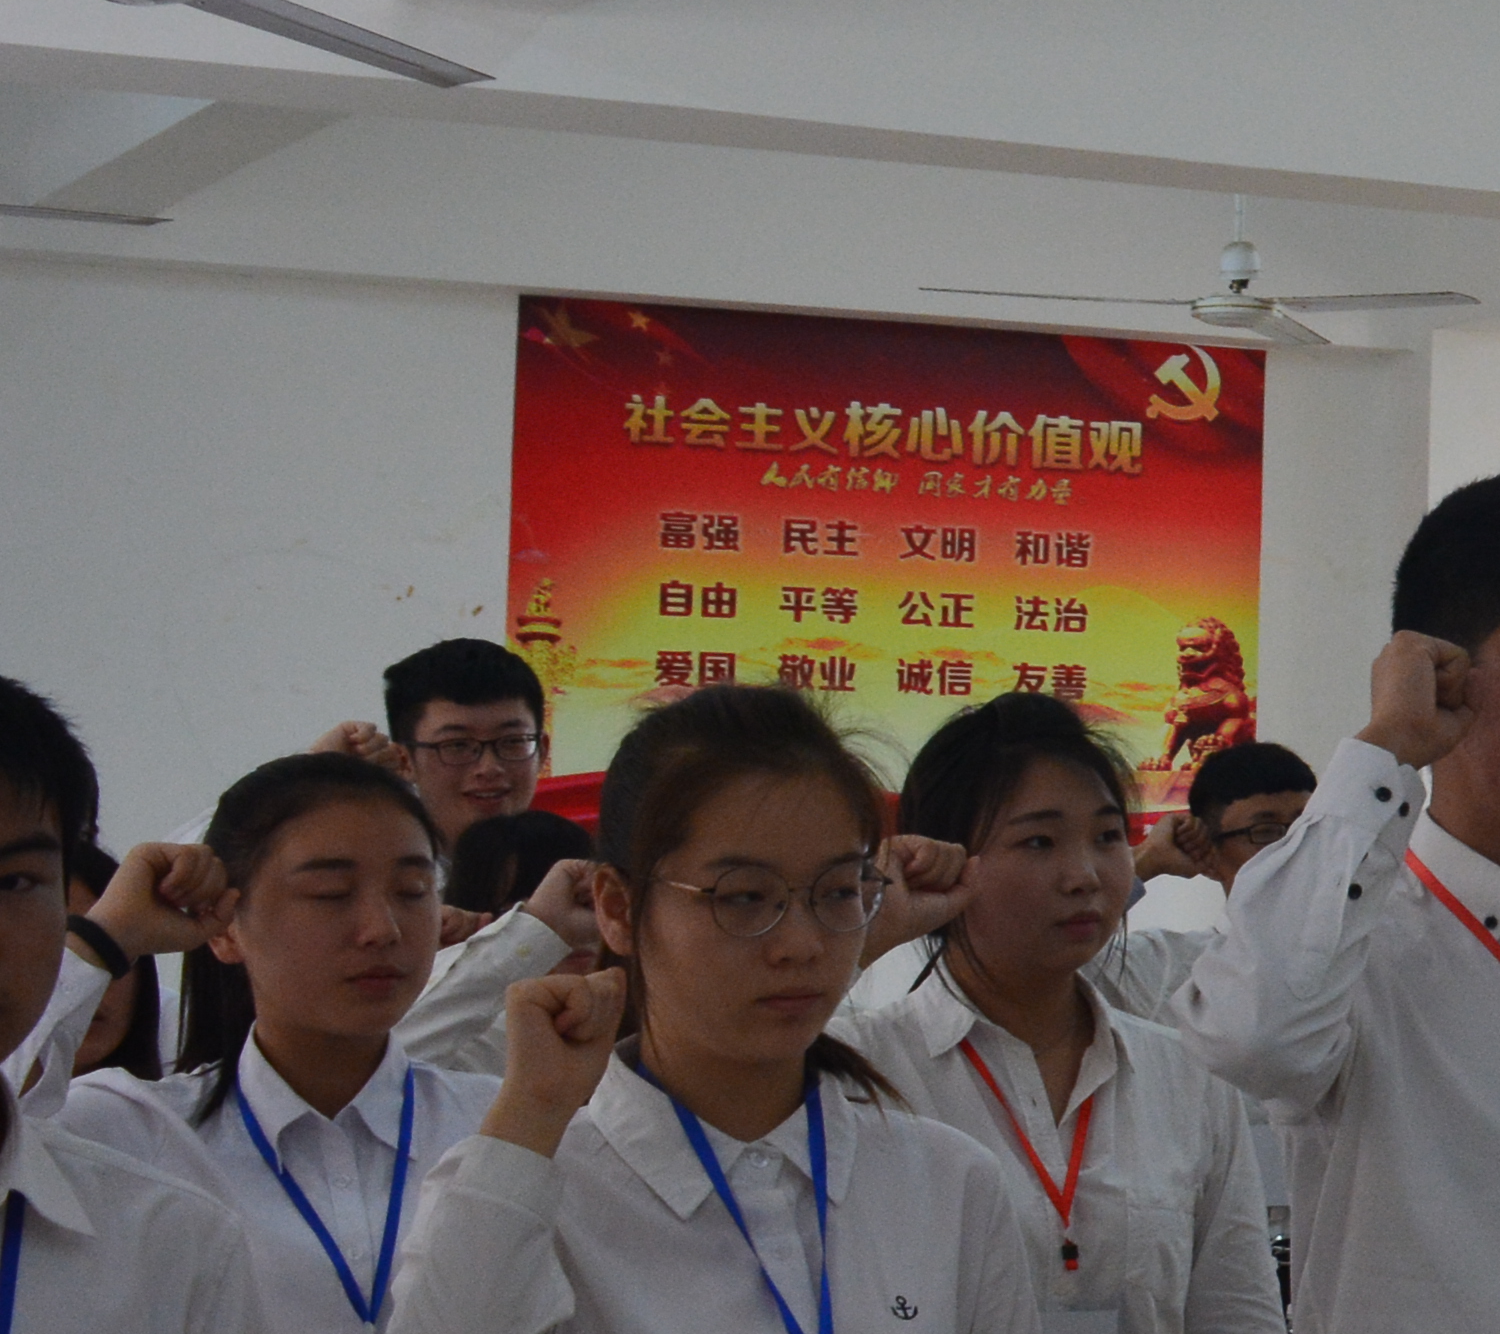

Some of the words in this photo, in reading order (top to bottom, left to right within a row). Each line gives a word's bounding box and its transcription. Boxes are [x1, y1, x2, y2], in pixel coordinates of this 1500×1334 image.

[623, 393, 1144, 475] 社会主义核心价值观
[760, 461, 898, 494] 人民有信仰
[917, 470, 1074, 506] 国家才有力量
[659, 511, 740, 552] 富强
[782, 518, 859, 556] 民主
[898, 524, 976, 563] 文明
[1014, 530, 1091, 568] 和谐
[659, 580, 738, 618] 自由
[778, 586, 859, 624] 平等
[897, 590, 975, 629] 公正
[1013, 595, 1090, 633] 法治
[655, 650, 737, 688] 爱国
[776, 653, 857, 694] 敬业
[896, 657, 975, 696] 诚信
[1012, 661, 1088, 702] 友善
